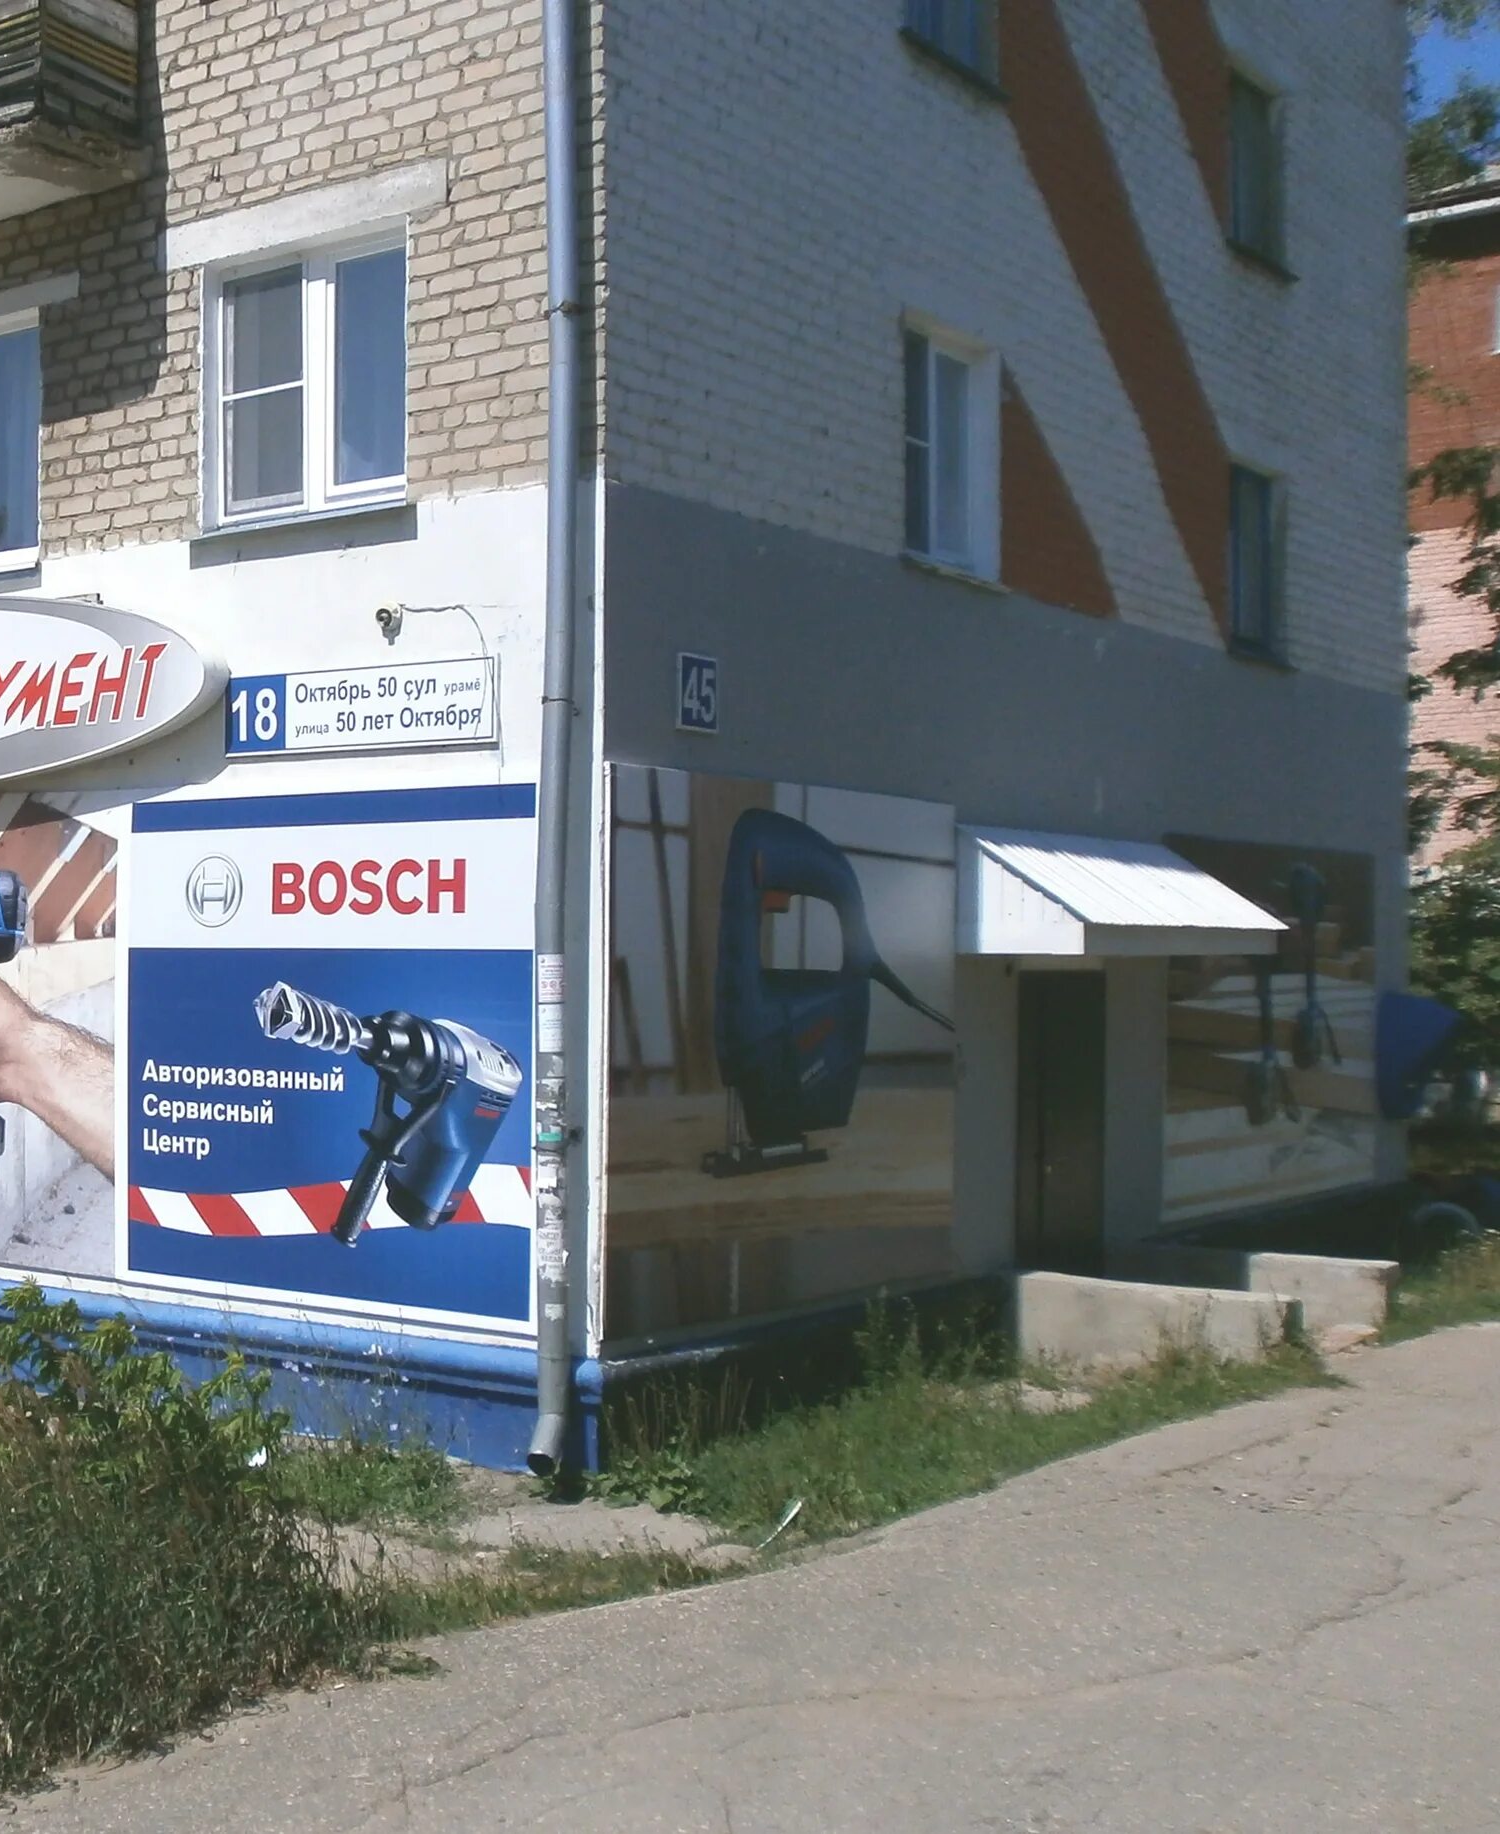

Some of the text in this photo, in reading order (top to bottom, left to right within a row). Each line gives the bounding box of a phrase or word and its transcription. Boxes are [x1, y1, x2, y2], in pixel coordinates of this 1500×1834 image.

[295, 679, 371, 704] Октябрь
[377, 676, 398, 698] 50
[683, 666, 715, 723] 45
[231, 687, 278, 742] 18
[295, 704, 482, 738] улица 50 лет Октября
[271, 858, 467, 916] BOSCH
[142, 1059, 344, 1092] Авторизованный
[142, 1093, 274, 1125] Сервисный
[142, 1128, 211, 1160] Центр
